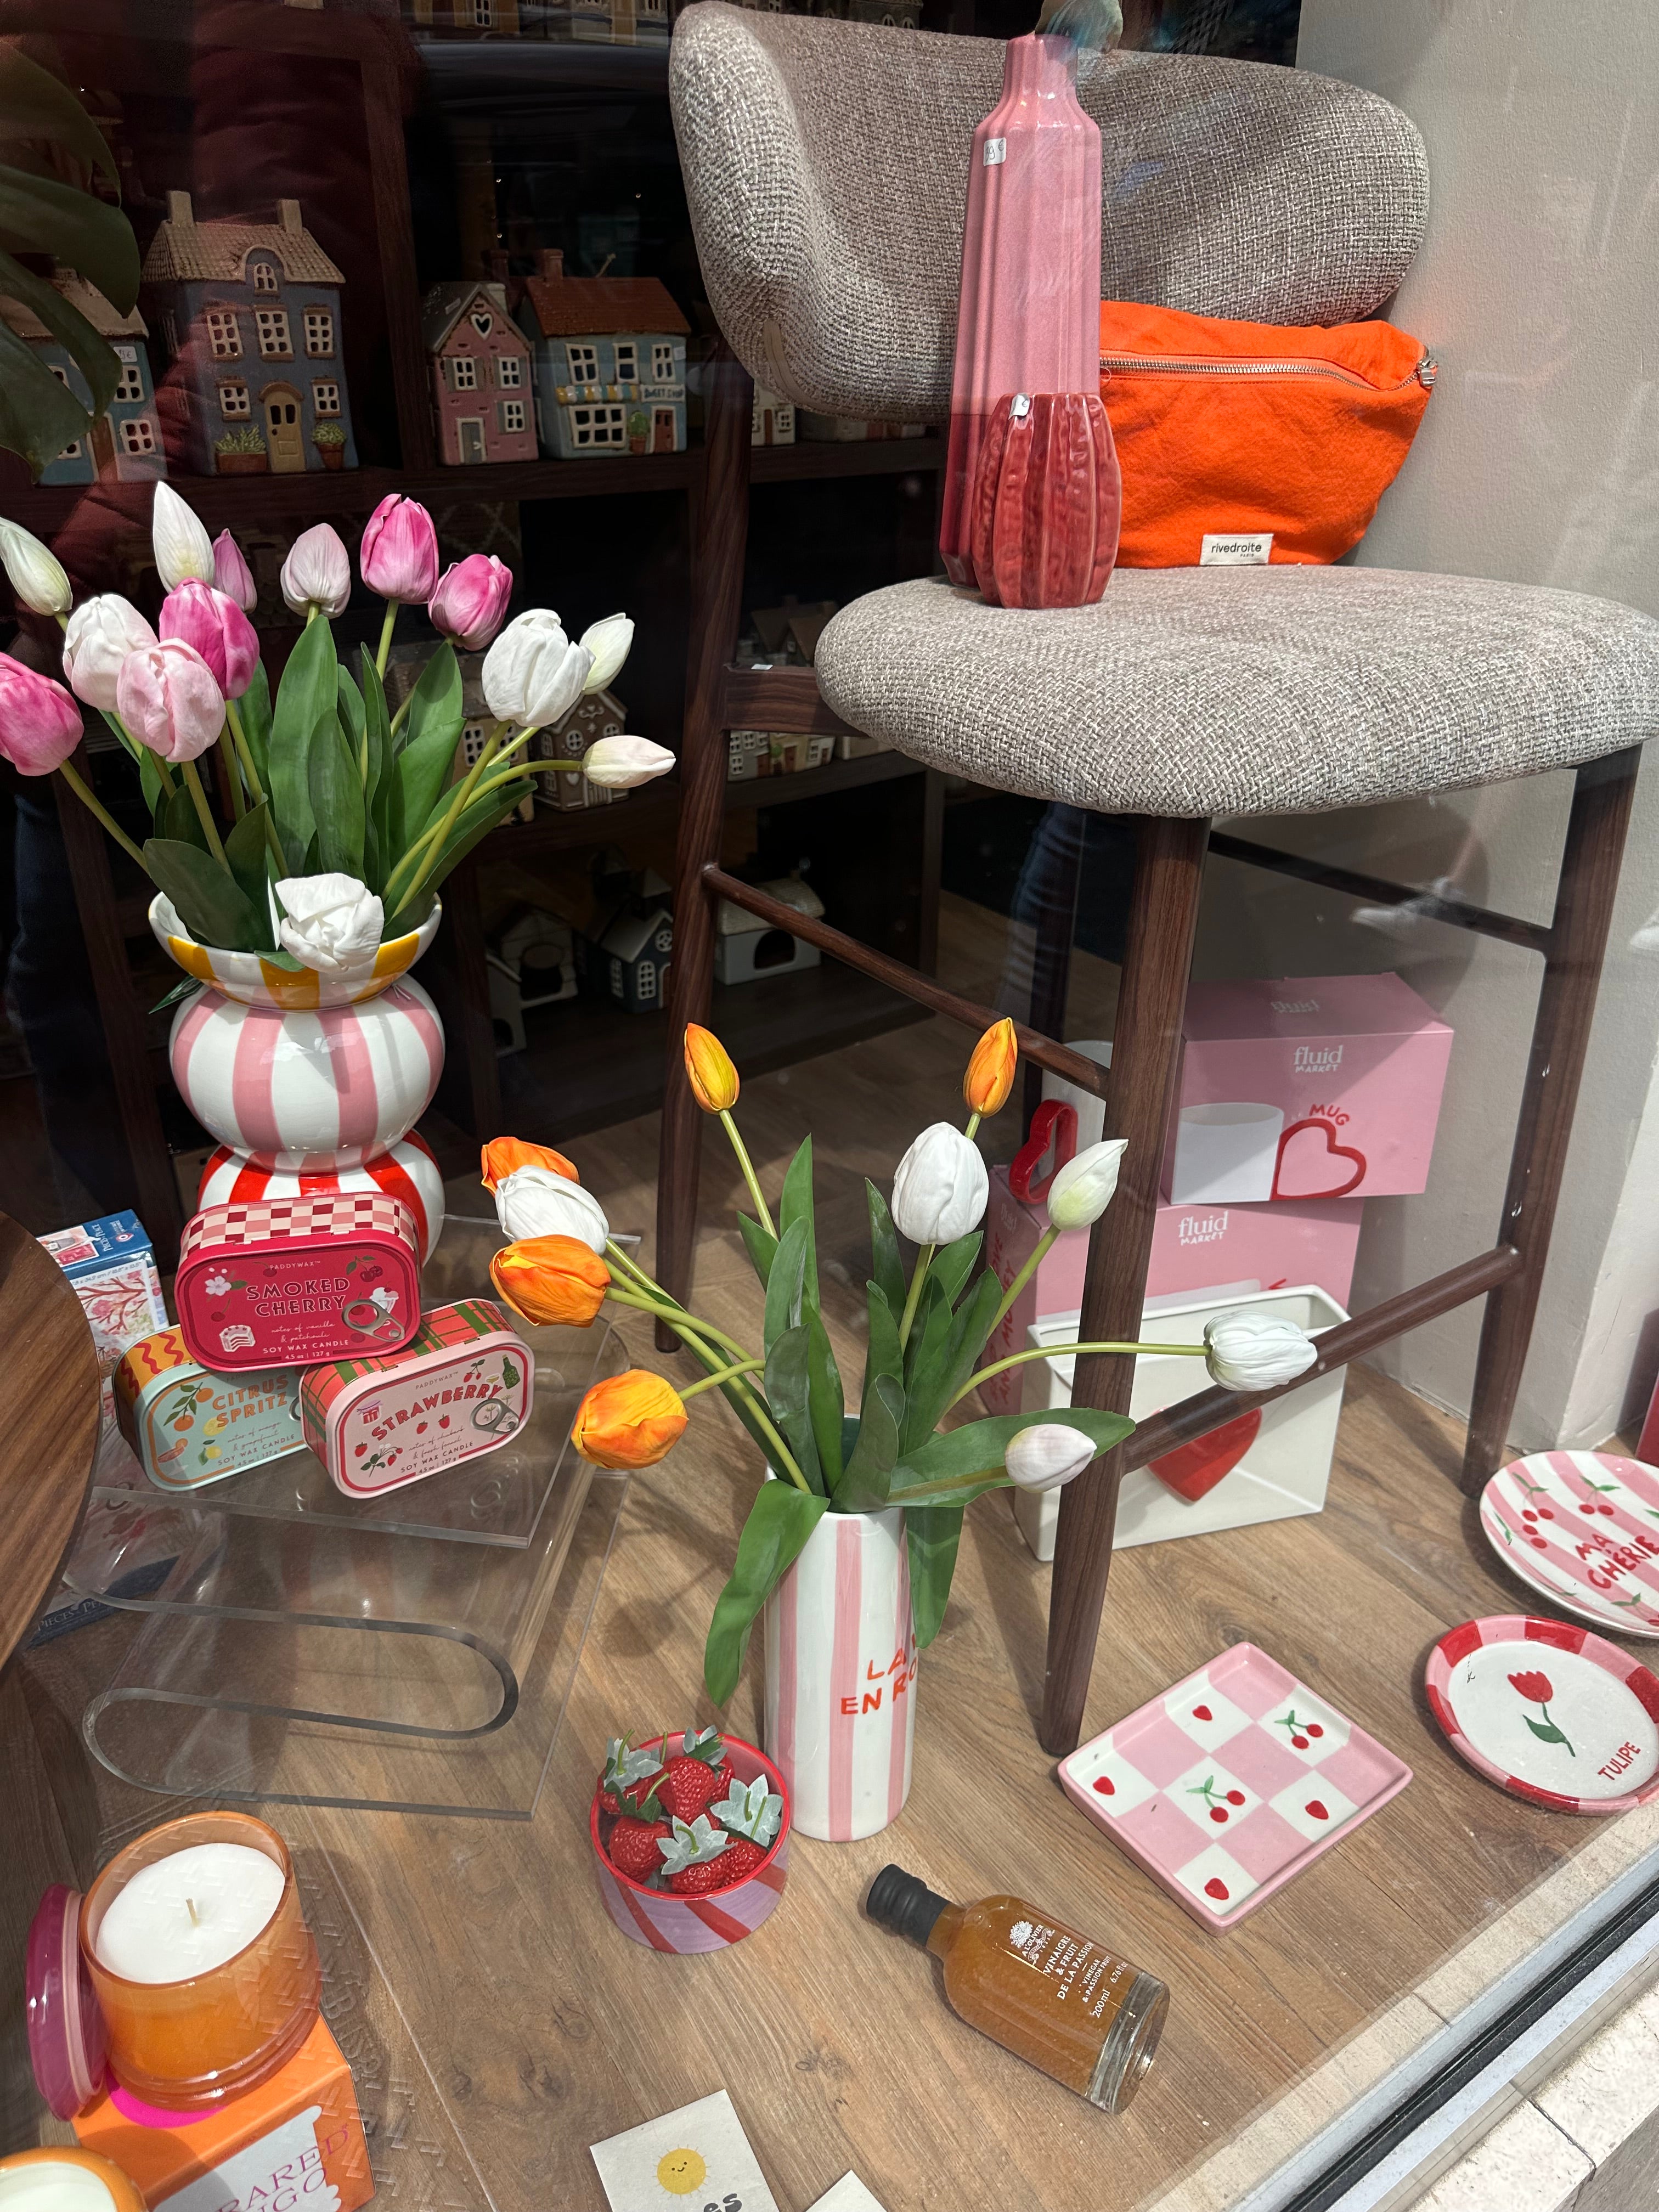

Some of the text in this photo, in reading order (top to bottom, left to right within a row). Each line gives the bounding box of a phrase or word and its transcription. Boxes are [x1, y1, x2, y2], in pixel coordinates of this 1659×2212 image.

[1211, 542, 1262, 554] rivedroite
[1293, 1045, 1343, 1066] fluid
[1295, 1063, 1339, 1073] MARKET
[1309, 1103, 1350, 1127] MUG
[1178, 1210, 1228, 1238] fluid
[1181, 1232, 1224, 1246] MARKET
[246, 1277, 349, 1300] SMOKED
[255, 1295, 346, 1317] CHERRY
[271, 1321, 336, 1333] notes of vanilla
[290, 1331, 330, 1343] patchouli
[263, 1346, 283, 1354] SOY
[313, 1340, 349, 1348] CANDLE
[212, 1374, 289, 1410] CITRUS
[216, 1391, 287, 1428] SPRITZ
[371, 1384, 504, 1441] STRAWBERRY
[248, 1427, 256, 1437] of
[428, 1436, 436, 1444] of
[217, 1434, 295, 1466] SOY WAX CANDLE
[400, 1441, 473, 1473] SOY WAX CANDLE
[421, 1444, 440, 1458] fresh
[1575, 1533, 1614, 1561] MA
[867, 1647, 906, 1680] LA
[840, 1687, 882, 1715] EN
[1598, 1741, 1641, 1780] TULIPE
[1024, 1924, 1044, 1951] L'OLIVIER
[1043, 1935, 1071, 1973] VINAIGRE
[1059, 1943, 1079, 1967] FRUIT
[1057, 1940, 1095, 2000] DE LA PASSION
[1082, 1959, 1101, 1984] VINEGAR
[1086, 1968, 1103, 1996] PASSION
[1099, 1955, 1112, 1969] FRUIT
[1110, 1970, 1121, 1984] 6.76
